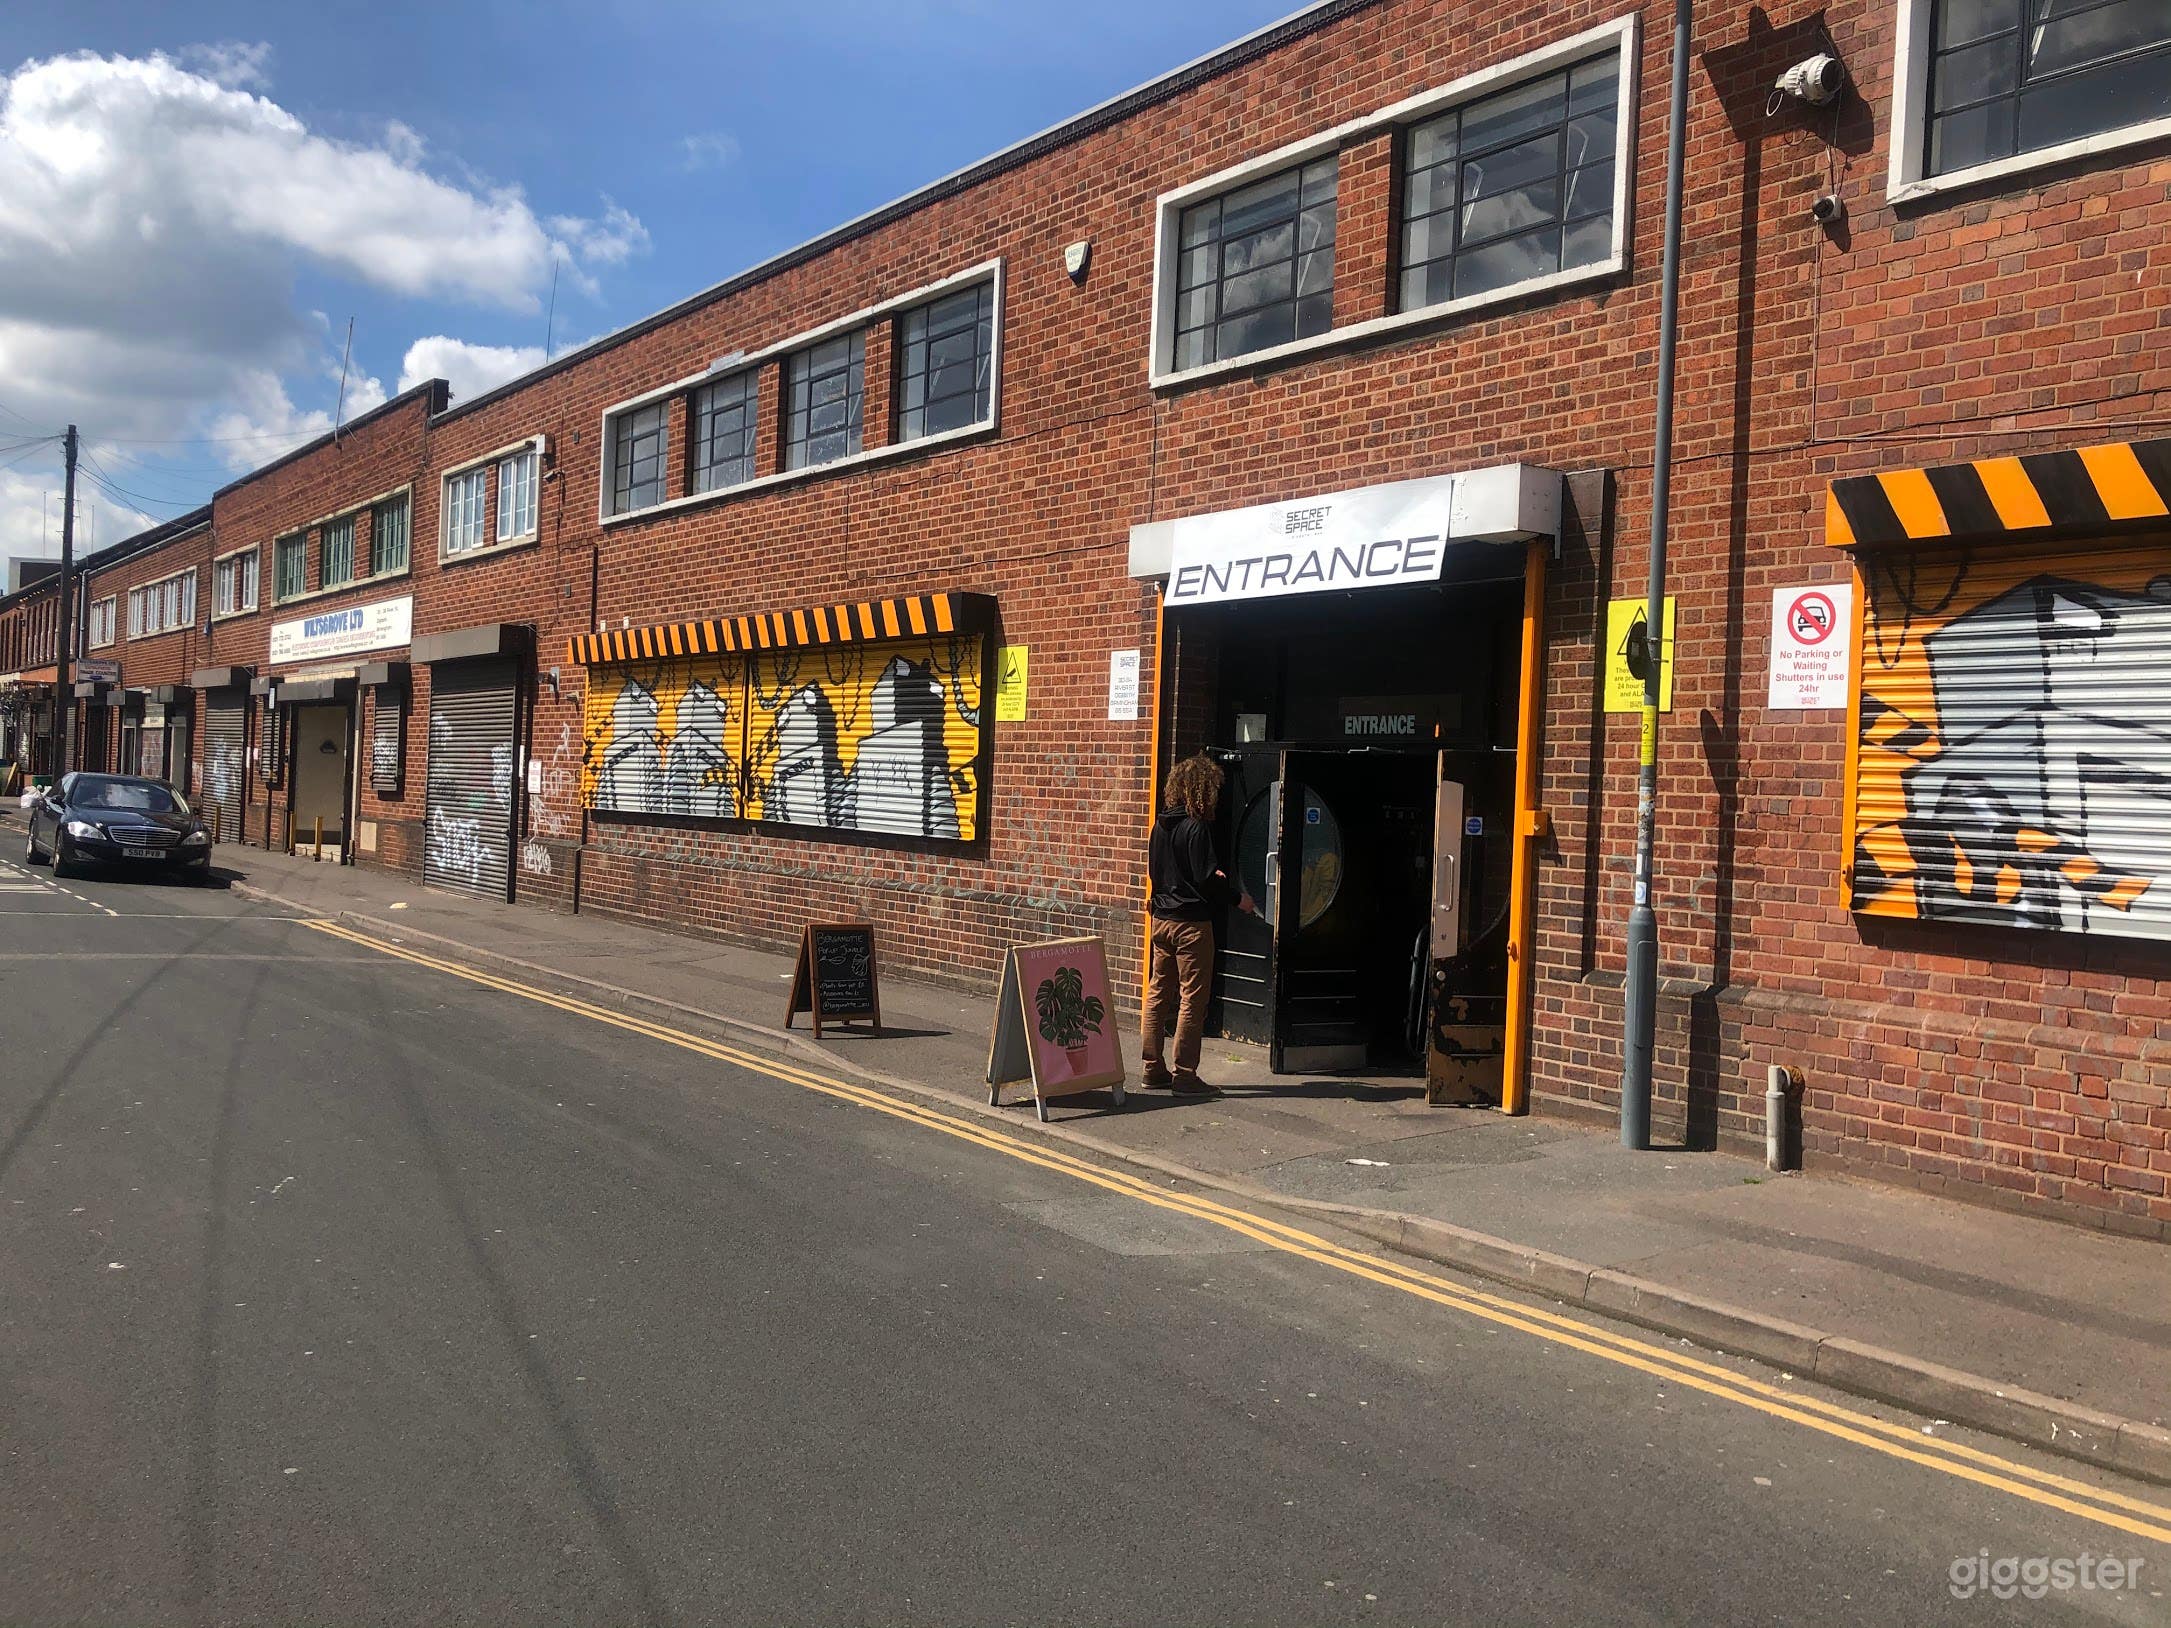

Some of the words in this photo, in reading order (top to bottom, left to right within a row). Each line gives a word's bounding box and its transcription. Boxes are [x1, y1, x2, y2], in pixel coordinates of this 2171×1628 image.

[1286, 506, 1332, 522] SECRET
[1285, 519, 1323, 533] SPACE
[1174, 535, 1439, 597] ENTRANCE
[304, 612, 348, 638] WILTSGROVE
[349, 609, 363, 630] LTD
[1795, 650, 1830, 659] Parking
[1793, 661, 1827, 671] Waiting
[1775, 673, 1813, 681] Shutters
[1798, 684, 1819, 692] 24hr
[1344, 715, 1415, 735] ENTRANCE
[1643, 724, 1650, 734] 2
[1030, 944, 1092, 959] BERGAMOTTE
